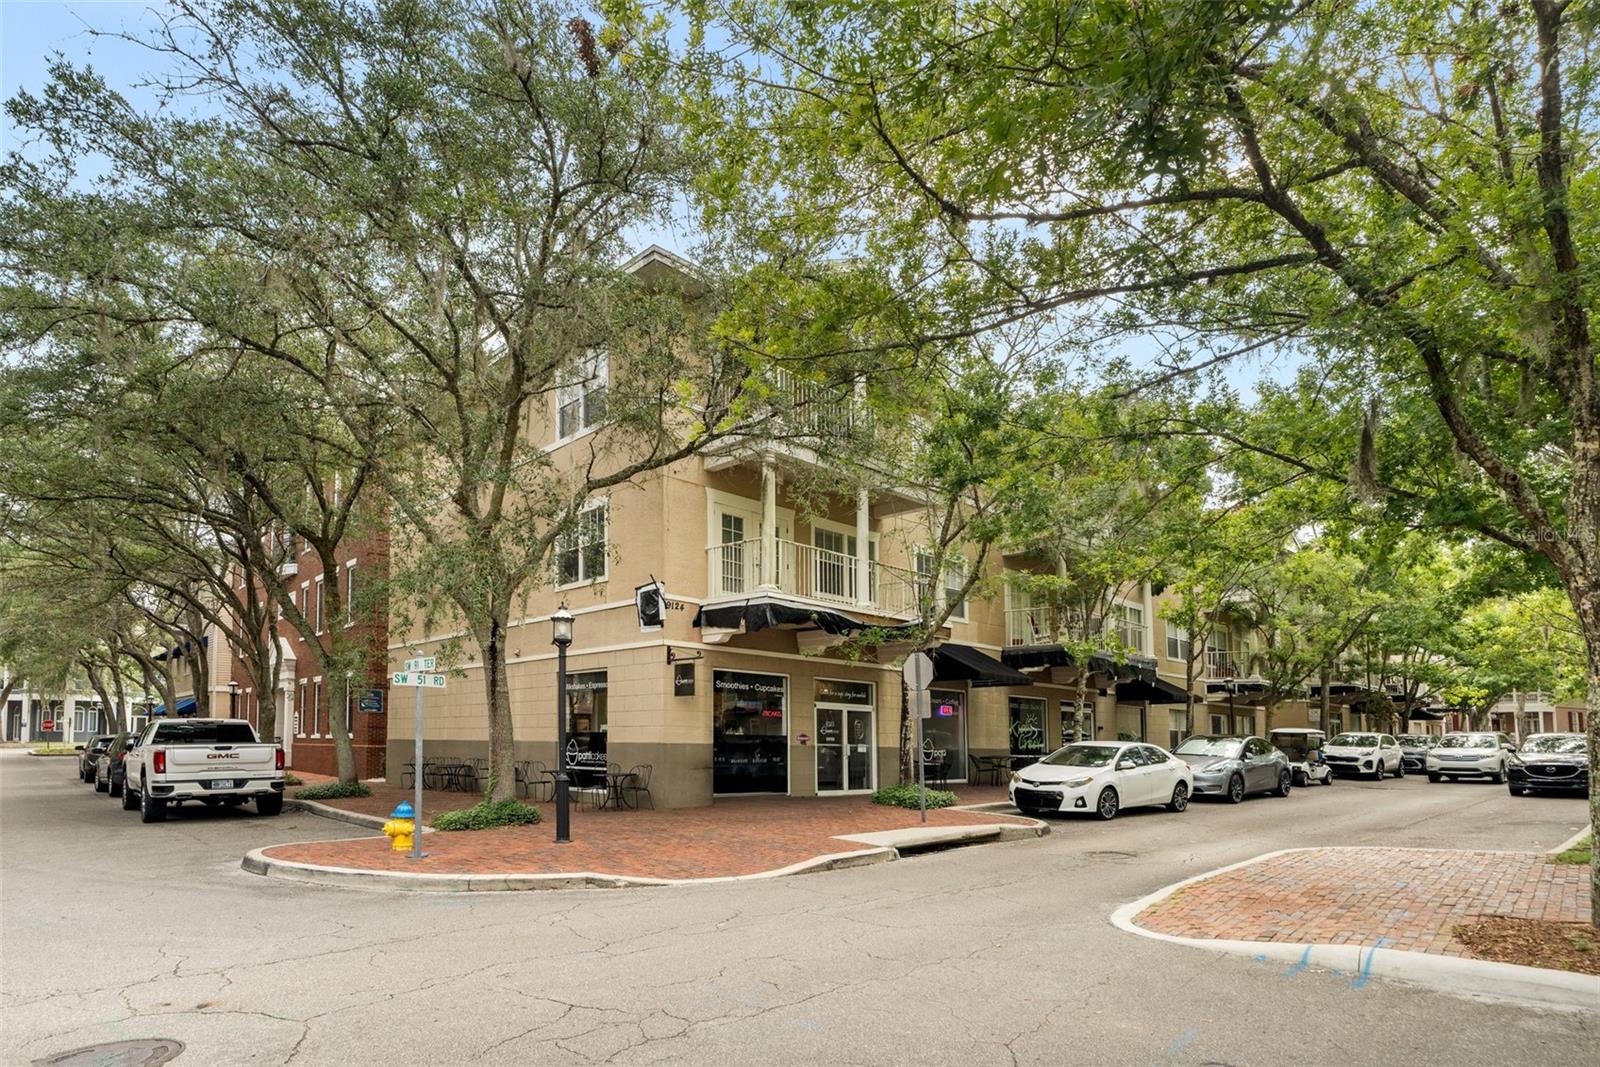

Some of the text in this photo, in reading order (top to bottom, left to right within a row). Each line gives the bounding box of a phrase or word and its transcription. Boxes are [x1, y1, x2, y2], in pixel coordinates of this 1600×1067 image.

[666, 601, 685, 612] 9124
[424, 658, 435, 669] TER
[394, 673, 445, 686] SW 51 RD
[715, 680, 750, 691] Smoothies
